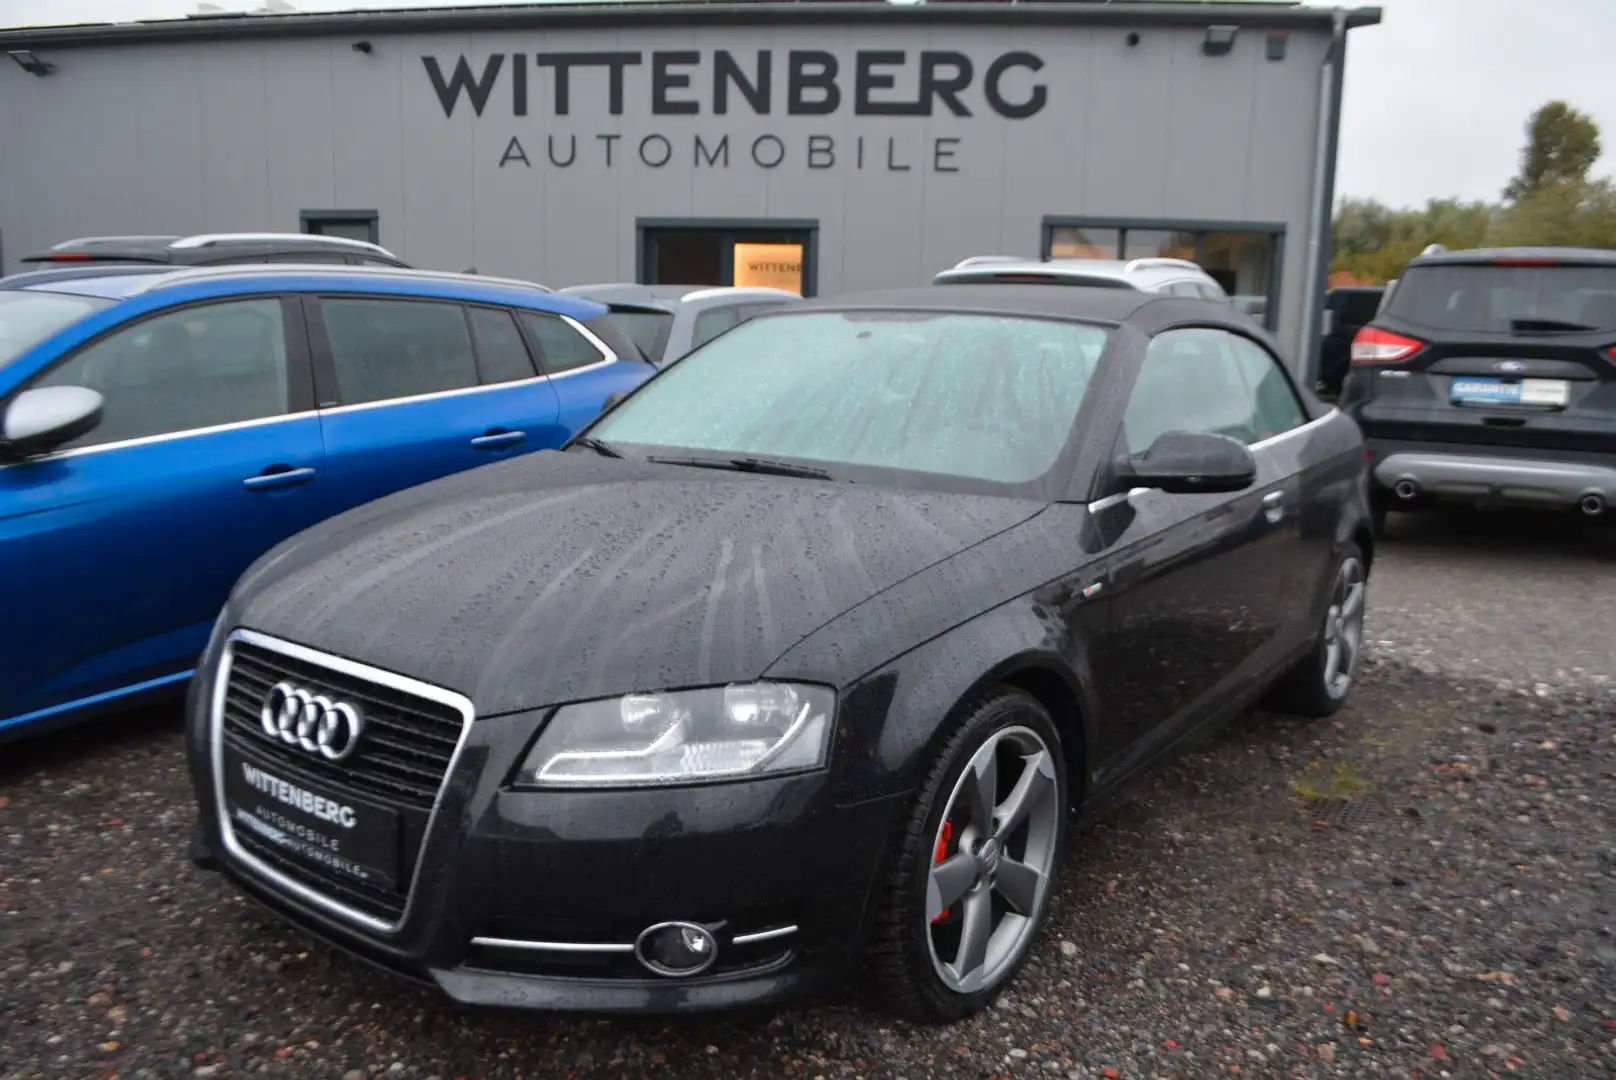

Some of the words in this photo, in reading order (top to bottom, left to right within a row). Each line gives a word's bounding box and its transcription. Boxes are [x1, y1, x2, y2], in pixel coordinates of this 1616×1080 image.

[420, 50, 1048, 119] WITTENBERG
[499, 133, 962, 172] AUTOMOBILE
[241, 761, 357, 829] WITTENBERG
[255, 805, 341, 852] AUTOMOBILE
